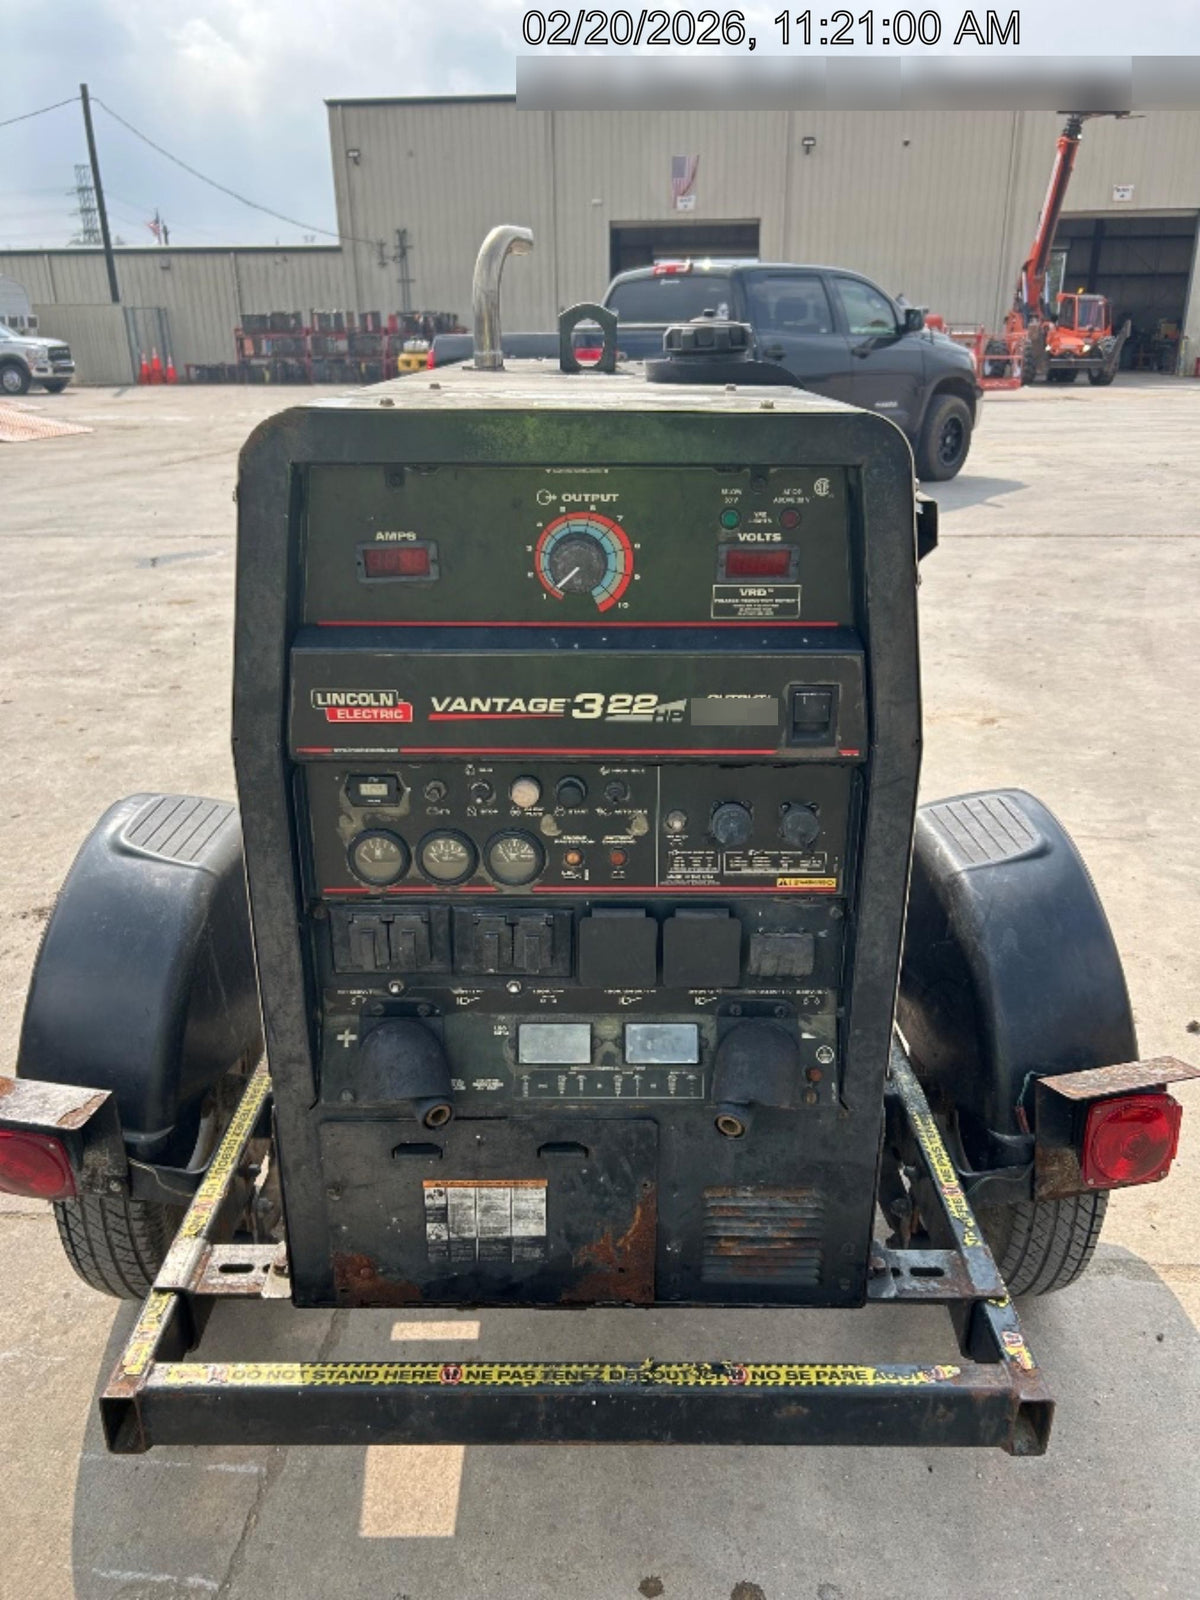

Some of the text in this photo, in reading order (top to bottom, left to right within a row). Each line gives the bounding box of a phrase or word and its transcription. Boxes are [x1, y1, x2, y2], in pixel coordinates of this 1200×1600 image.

[561, 493, 620, 502] OUTPUT
[375, 531, 417, 541] AMPS
[737, 532, 782, 542] VOLTS
[316, 692, 394, 706] LINCOLN
[430, 697, 567, 713] VANTAGE
[572, 692, 659, 719] 322
[336, 709, 404, 719] ELECTRIC
[231, 1370, 438, 1380] DO NOT STAND HERE
[466, 1370, 493, 1380] NE
[498, 1370, 536, 1380] PAS
[541, 1370, 606, 1380] TENEZ
[751, 1370, 781, 1380] NO
[785, 1370, 811, 1380] SE
[815, 1370, 867, 1380] PARE
